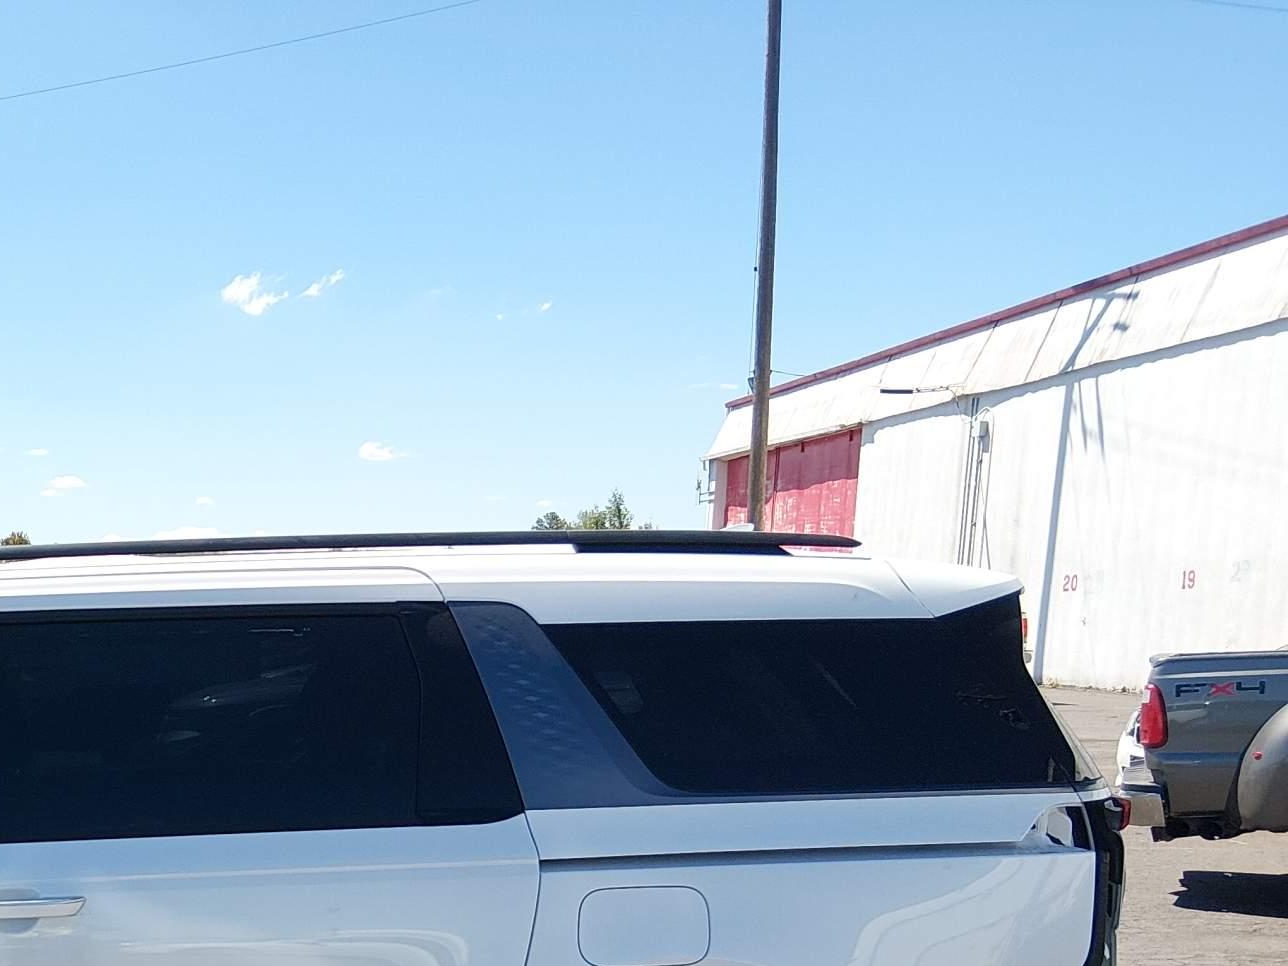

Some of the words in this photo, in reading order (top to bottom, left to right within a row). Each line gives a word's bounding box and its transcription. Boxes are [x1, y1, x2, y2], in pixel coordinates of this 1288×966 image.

[1063, 574, 1078, 592] 20
[1181, 570, 1196, 590] 19
[1175, 680, 1266, 698] FX4
